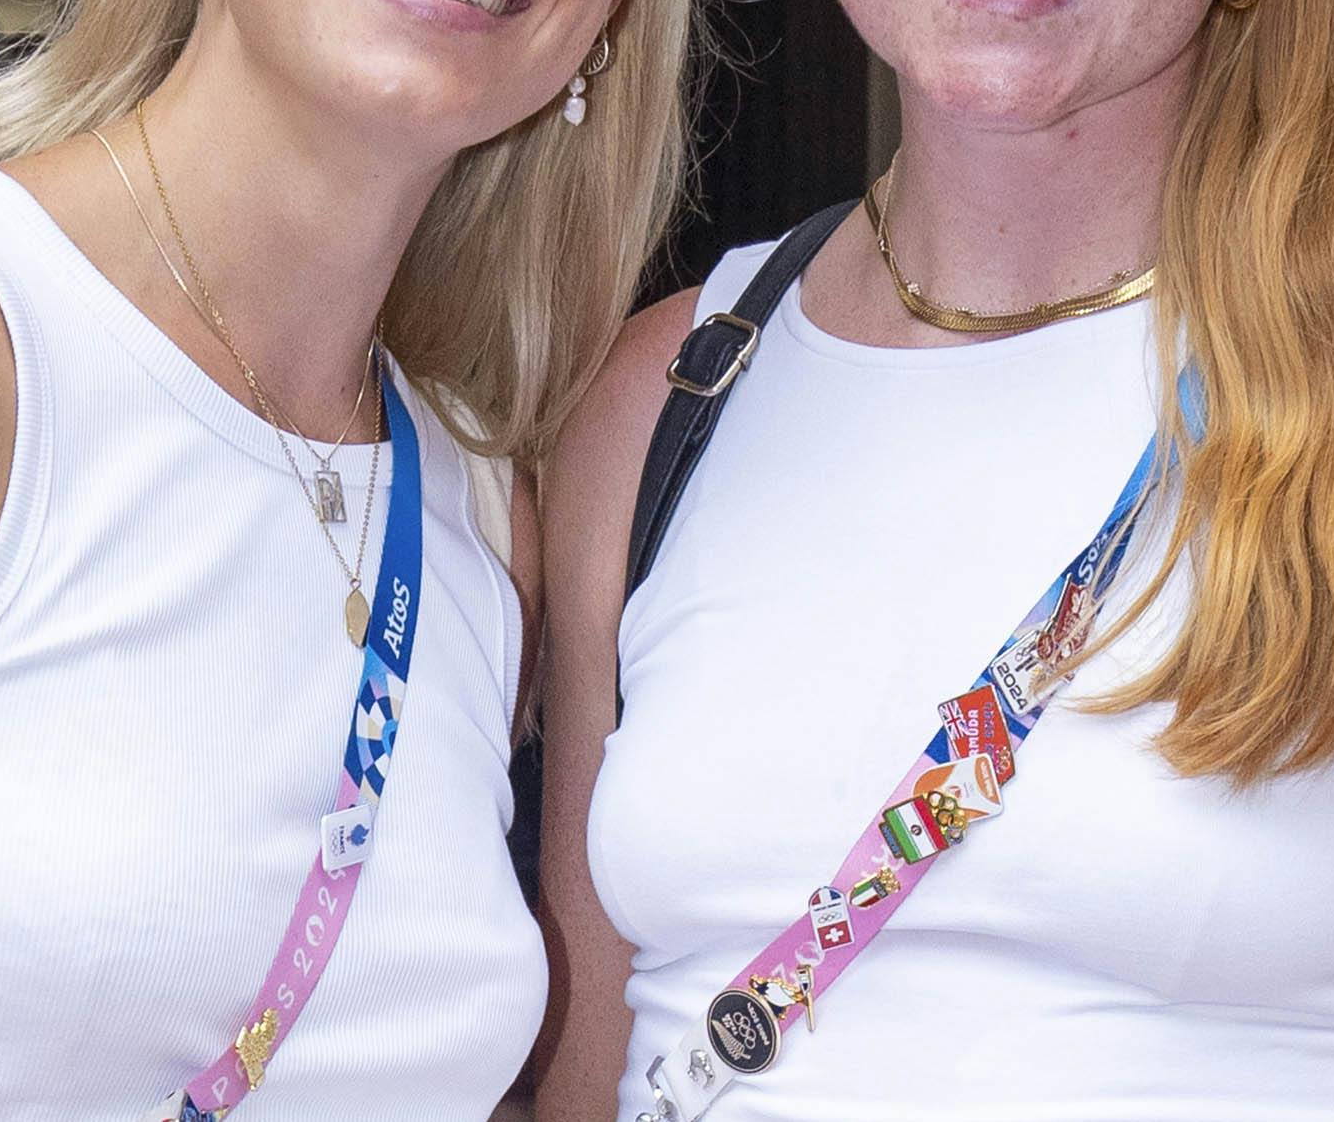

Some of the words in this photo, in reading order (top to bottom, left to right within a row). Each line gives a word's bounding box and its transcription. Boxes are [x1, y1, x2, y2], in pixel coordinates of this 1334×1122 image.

[383, 576, 410, 660] Atos
[996, 661, 1029, 710] 2024
[968, 709, 979, 757] RMUDA
